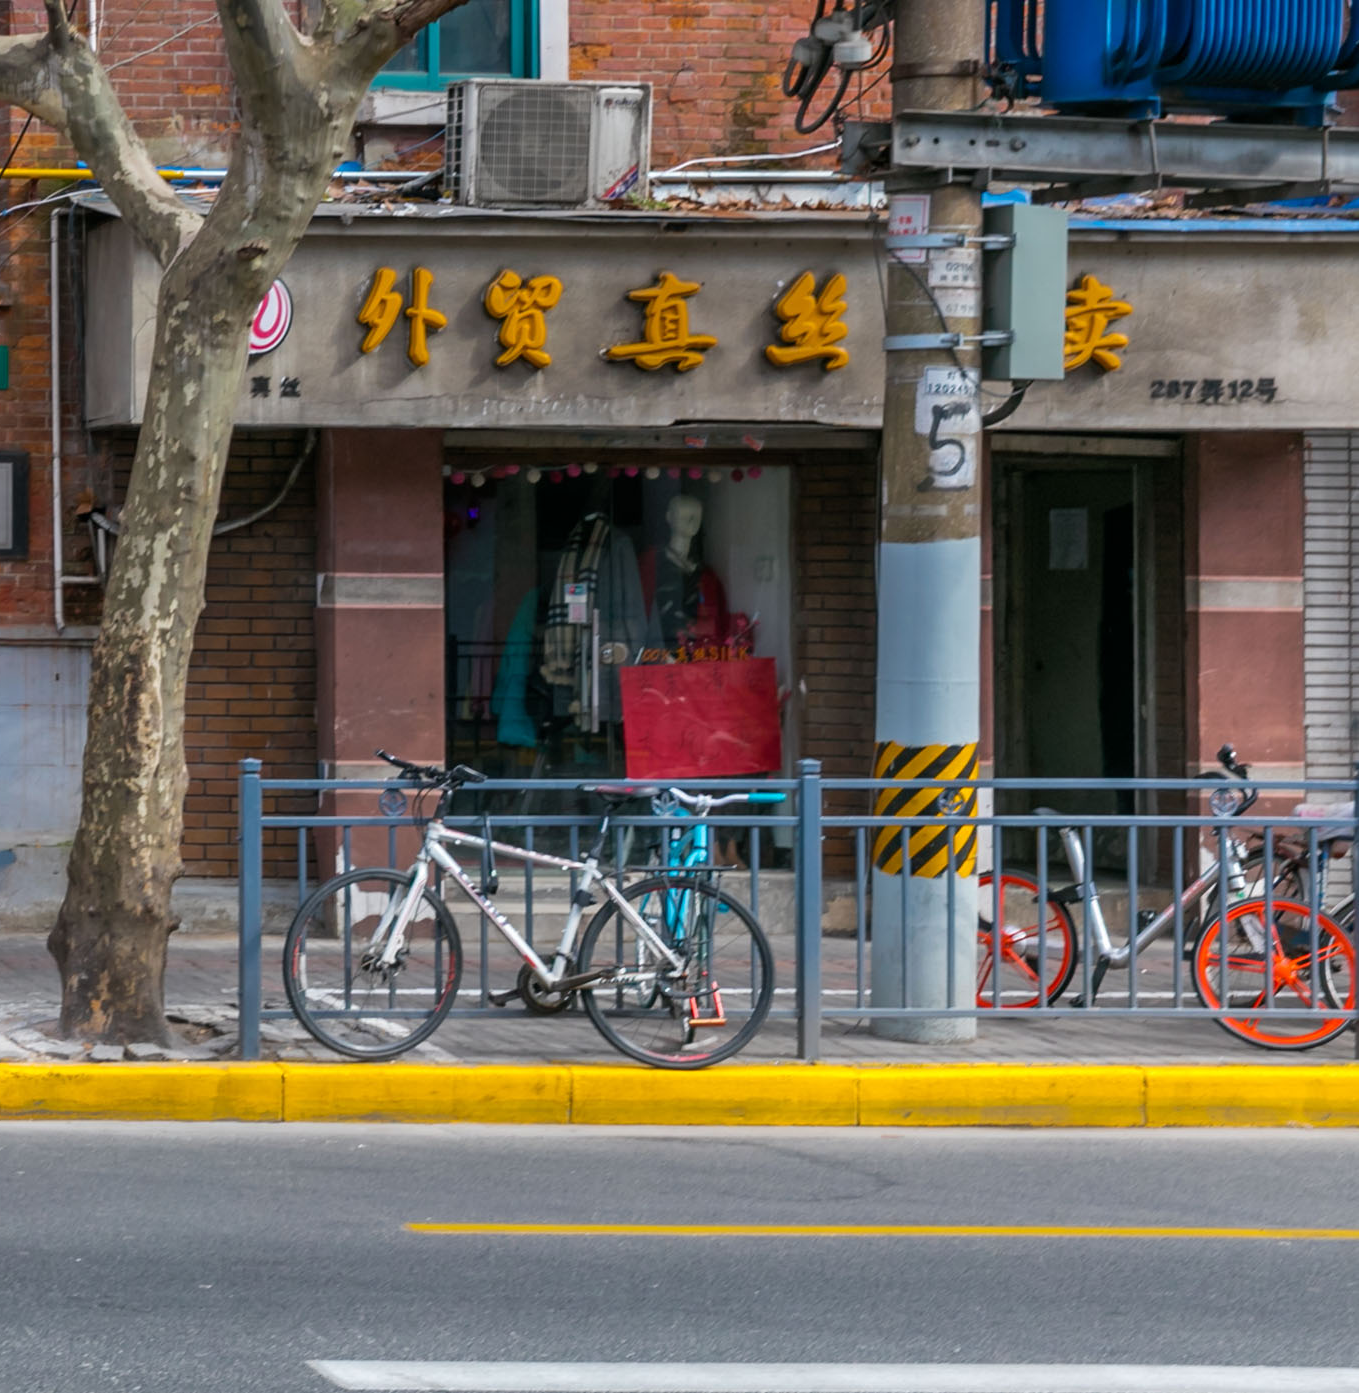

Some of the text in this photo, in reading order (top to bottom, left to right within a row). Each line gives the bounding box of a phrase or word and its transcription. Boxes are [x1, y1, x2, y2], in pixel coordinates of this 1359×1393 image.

[358, 266, 1134, 374] 外贸真丝卖
